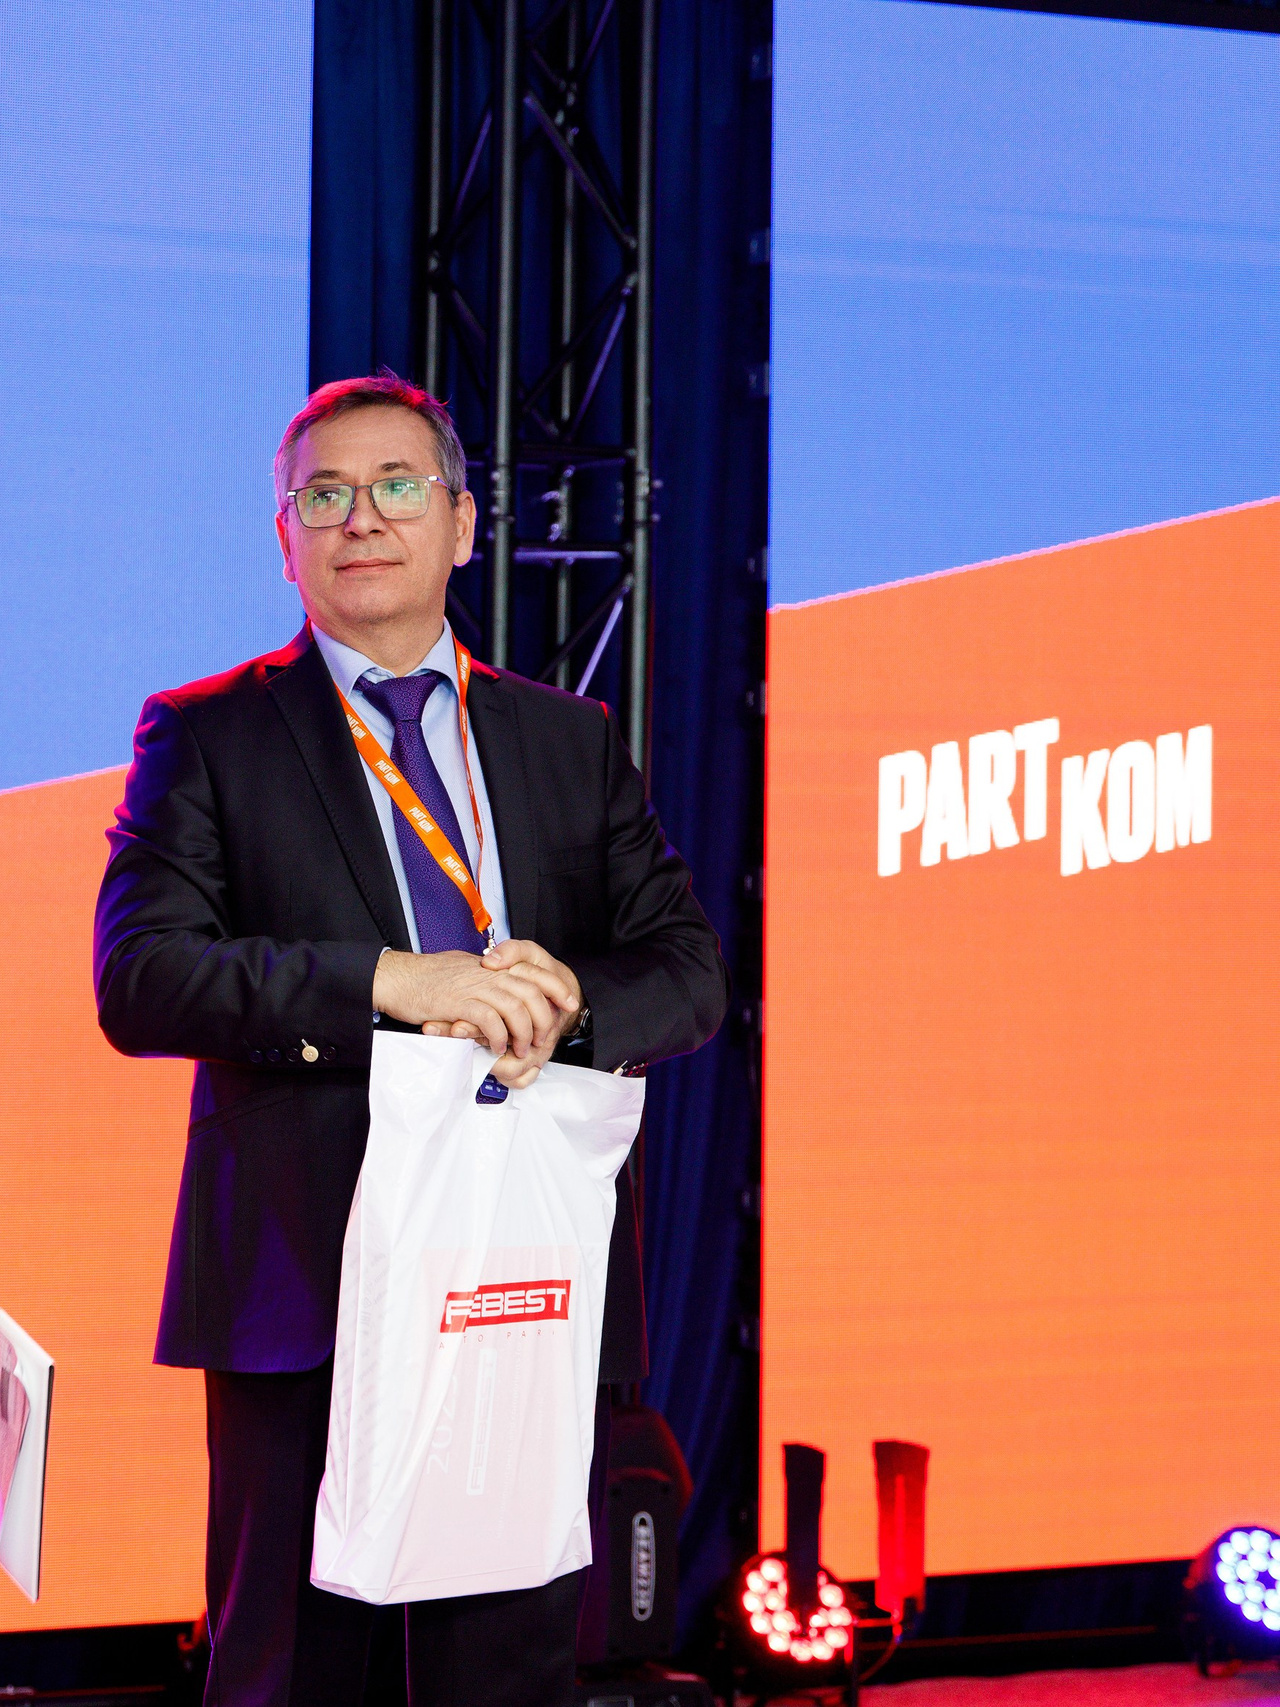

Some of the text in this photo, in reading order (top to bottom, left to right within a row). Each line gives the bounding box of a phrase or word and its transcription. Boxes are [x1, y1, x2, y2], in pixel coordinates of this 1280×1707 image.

[375, 759, 393, 775] PART
[878, 717, 1212, 877] PART KOM
[408, 806, 428, 821] PART
[442, 855, 461, 871] PART
[445, 1288, 567, 1325] FEBEST
[439, 1334, 484, 1350] ATO
[470, 1353, 495, 1491] FEBEST
